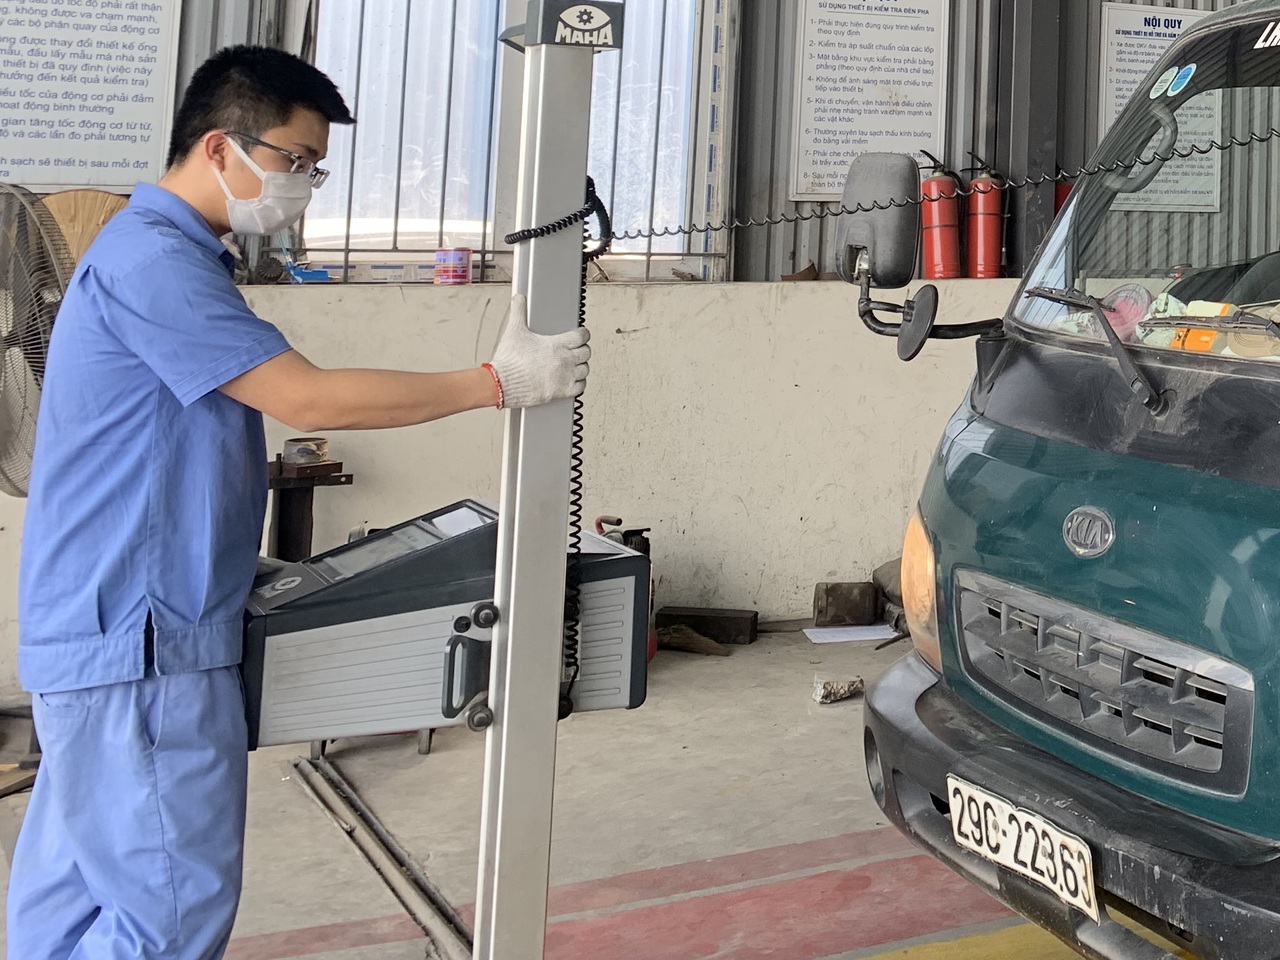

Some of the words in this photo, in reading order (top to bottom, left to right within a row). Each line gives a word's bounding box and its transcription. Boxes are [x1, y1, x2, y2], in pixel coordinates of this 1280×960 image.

[72, 22, 97, 33] quay
[1143, 15, 1161, 30] NỘI
[1163, 18, 1183, 30] QUY
[554, 20, 614, 46] MAHA
[50, 38, 73, 49] thay
[58, 63, 78, 73] quy
[1, 117, 26, 128] gian
[90, 160, 109, 168] sau
